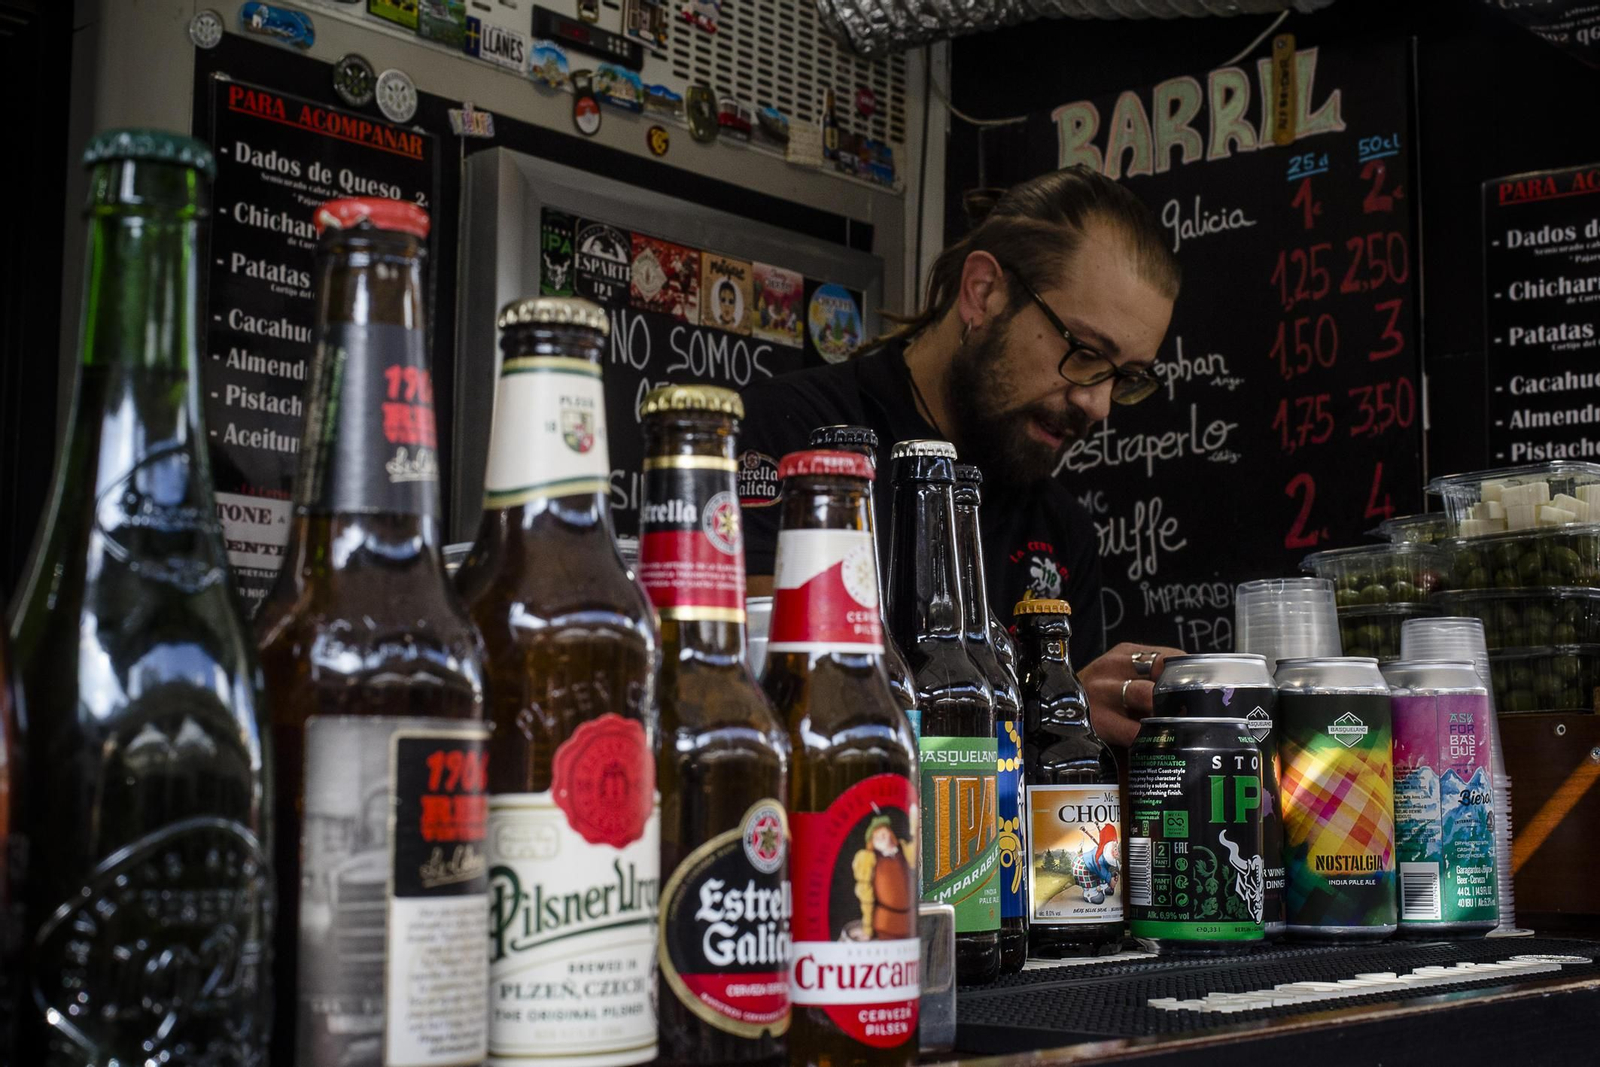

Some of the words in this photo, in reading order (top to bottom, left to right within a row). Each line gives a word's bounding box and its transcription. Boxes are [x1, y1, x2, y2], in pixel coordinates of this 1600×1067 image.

[482, 26, 524, 63] LLANES
[228, 84, 286, 119] PARA
[298, 104, 424, 157] ACOMPAÑAR
[235, 141, 301, 178] Dados
[308, 161, 333, 186] de
[338, 168, 402, 201] Queso
[1499, 176, 1558, 203] PARA
[1506, 224, 1577, 249] Dados
[231, 252, 311, 288] Patatas
[610, 308, 651, 370] NO
[1367, 297, 1406, 362] 3
[1509, 321, 1595, 347] Patatas
[1363, 462, 1397, 520] 4
[1330, 726, 1367, 734] BASQUELAND
[1449, 713, 1474, 723] ASK
[1449, 724, 1475, 735] FOR
[1153, 735, 1175, 743] BERLIN
[1450, 735, 1476, 746] BAS
[1450, 745, 1476, 759] QUE
[1103, 792, 1114, 803] Mc
[932, 775, 998, 883] IPA
[1157, 844, 1166, 856] 2
[1315, 854, 1384, 872] NOSTALGIA
[933, 845, 1000, 903] IMPARABLE
[489, 864, 614, 962] Pilsner
[1159, 911, 1178, 920] 6,9%
[1178, 911, 1190, 920] vol
